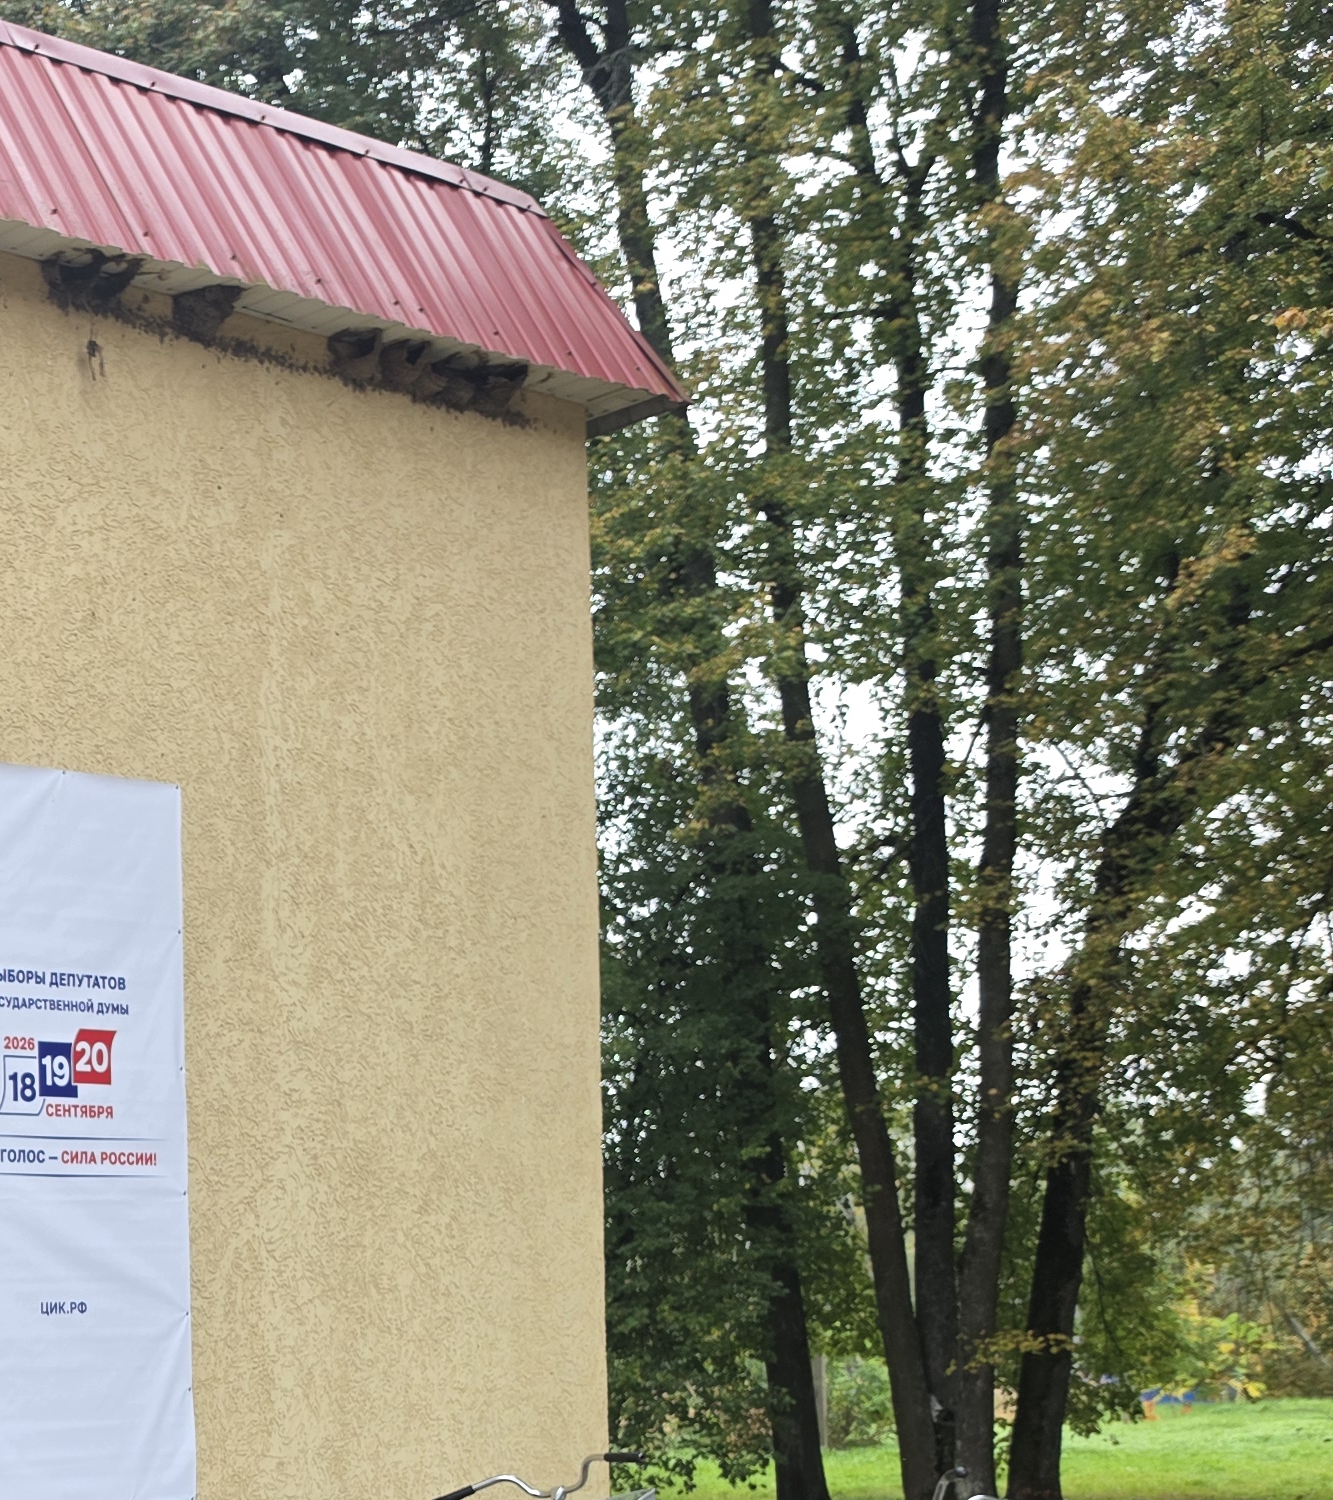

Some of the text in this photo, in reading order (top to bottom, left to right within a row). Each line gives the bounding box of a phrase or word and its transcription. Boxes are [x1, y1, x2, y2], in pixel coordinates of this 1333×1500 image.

[48, 971, 126, 991] ДЕПУТАТОВ
[96, 1001, 129, 1016] ДУМЫ
[3, 1035, 36, 1051] 2026
[8, 1040, 109, 1103] 18 19 20
[45, 1103, 114, 1120] СЕНТЯБРЯ
[0, 1149, 45, 1164] ГОЛОС
[61, 1150, 97, 1165] СИЛА
[100, 1151, 157, 1167] РОССИИ!
[40, 1300, 88, 1316] ЦИК.РФ
